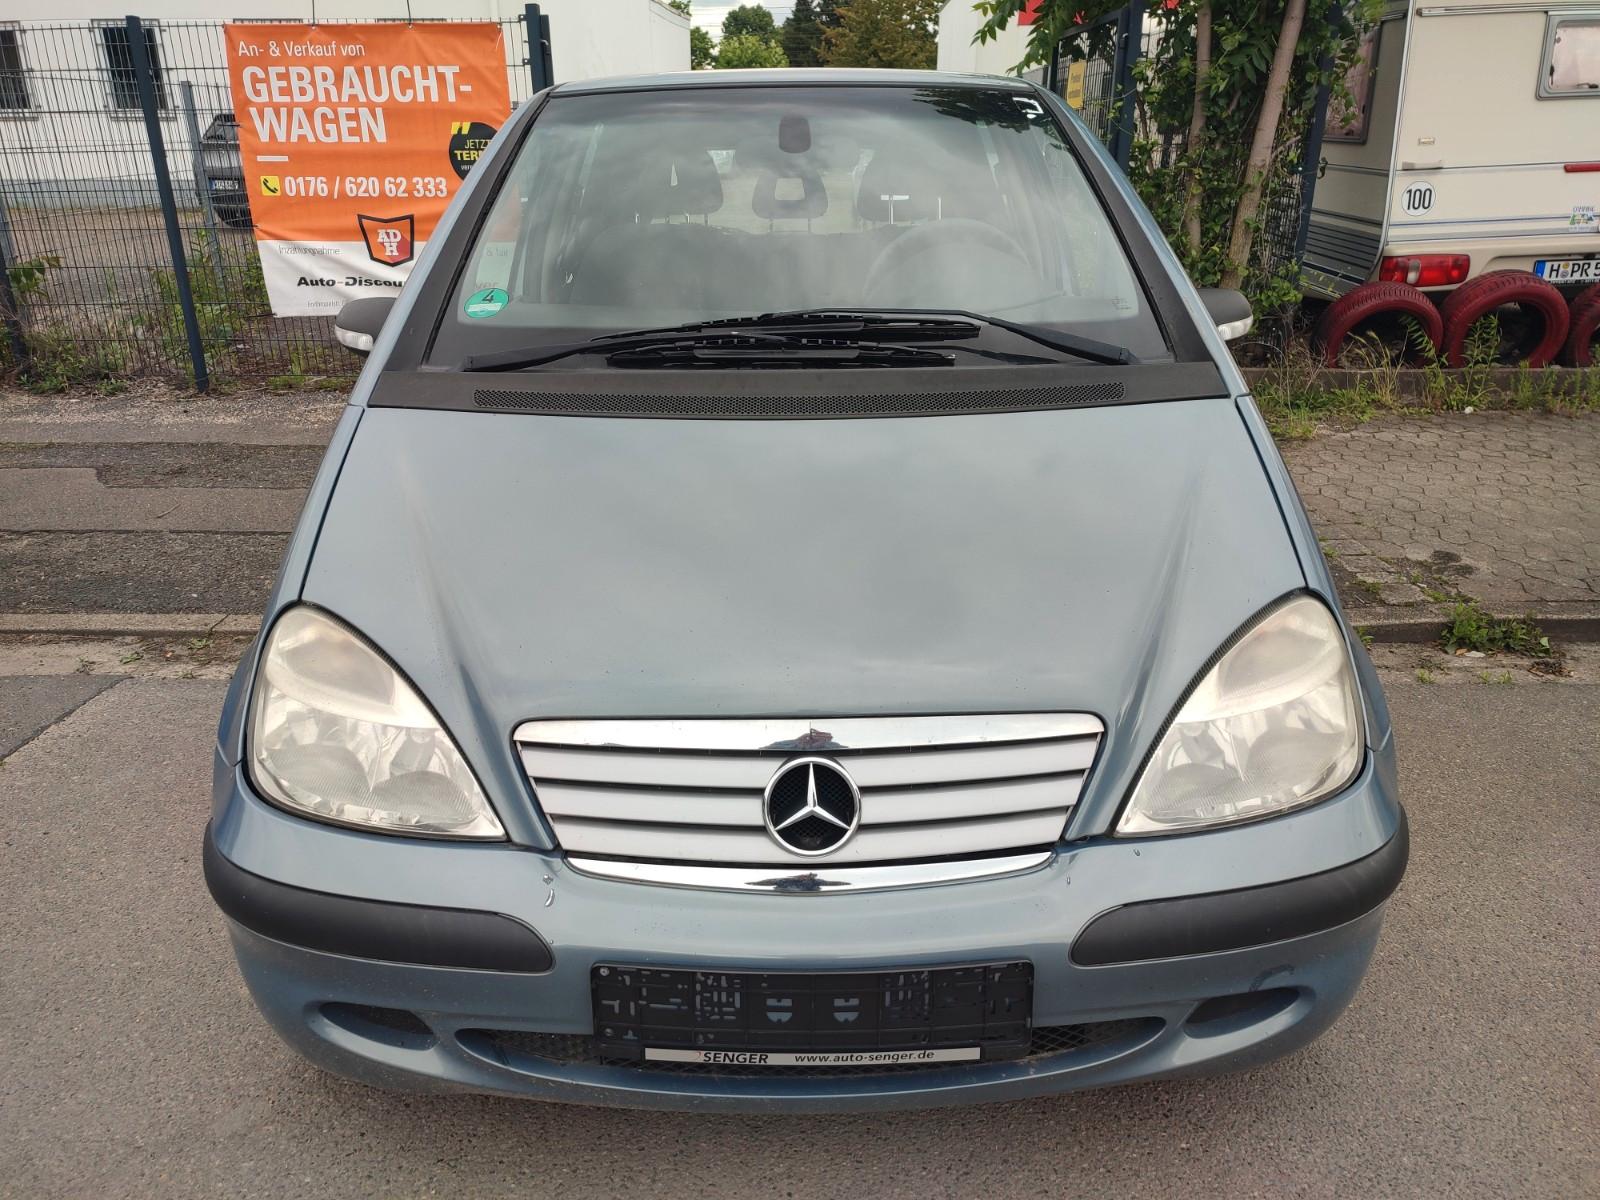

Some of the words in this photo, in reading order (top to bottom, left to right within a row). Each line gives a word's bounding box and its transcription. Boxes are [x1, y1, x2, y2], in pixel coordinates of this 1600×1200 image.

[238, 41, 264, 57] An-
[269, 41, 281, 57] &
[283, 41, 337, 57] Verkauf
[340, 44, 366, 57] von
[242, 65, 472, 103] GEBRAUCHT-
[249, 107, 387, 143] WAGEN
[284, 176, 329, 197] 0176
[333, 176, 340, 199] /
[345, 177, 380, 197] 620
[384, 177, 408, 197] 62
[412, 177, 448, 197] 333
[1406, 188, 1433, 211] 100
[1549, 263, 1561, 279] H
[1570, 262, 1591, 278] PR
[297, 276, 406, 288] Auto-Discou
[482, 289, 496, 304] 4
[703, 1051, 769, 1064] SENGER
[794, 1050, 935, 1063] www.auto-senger.de
